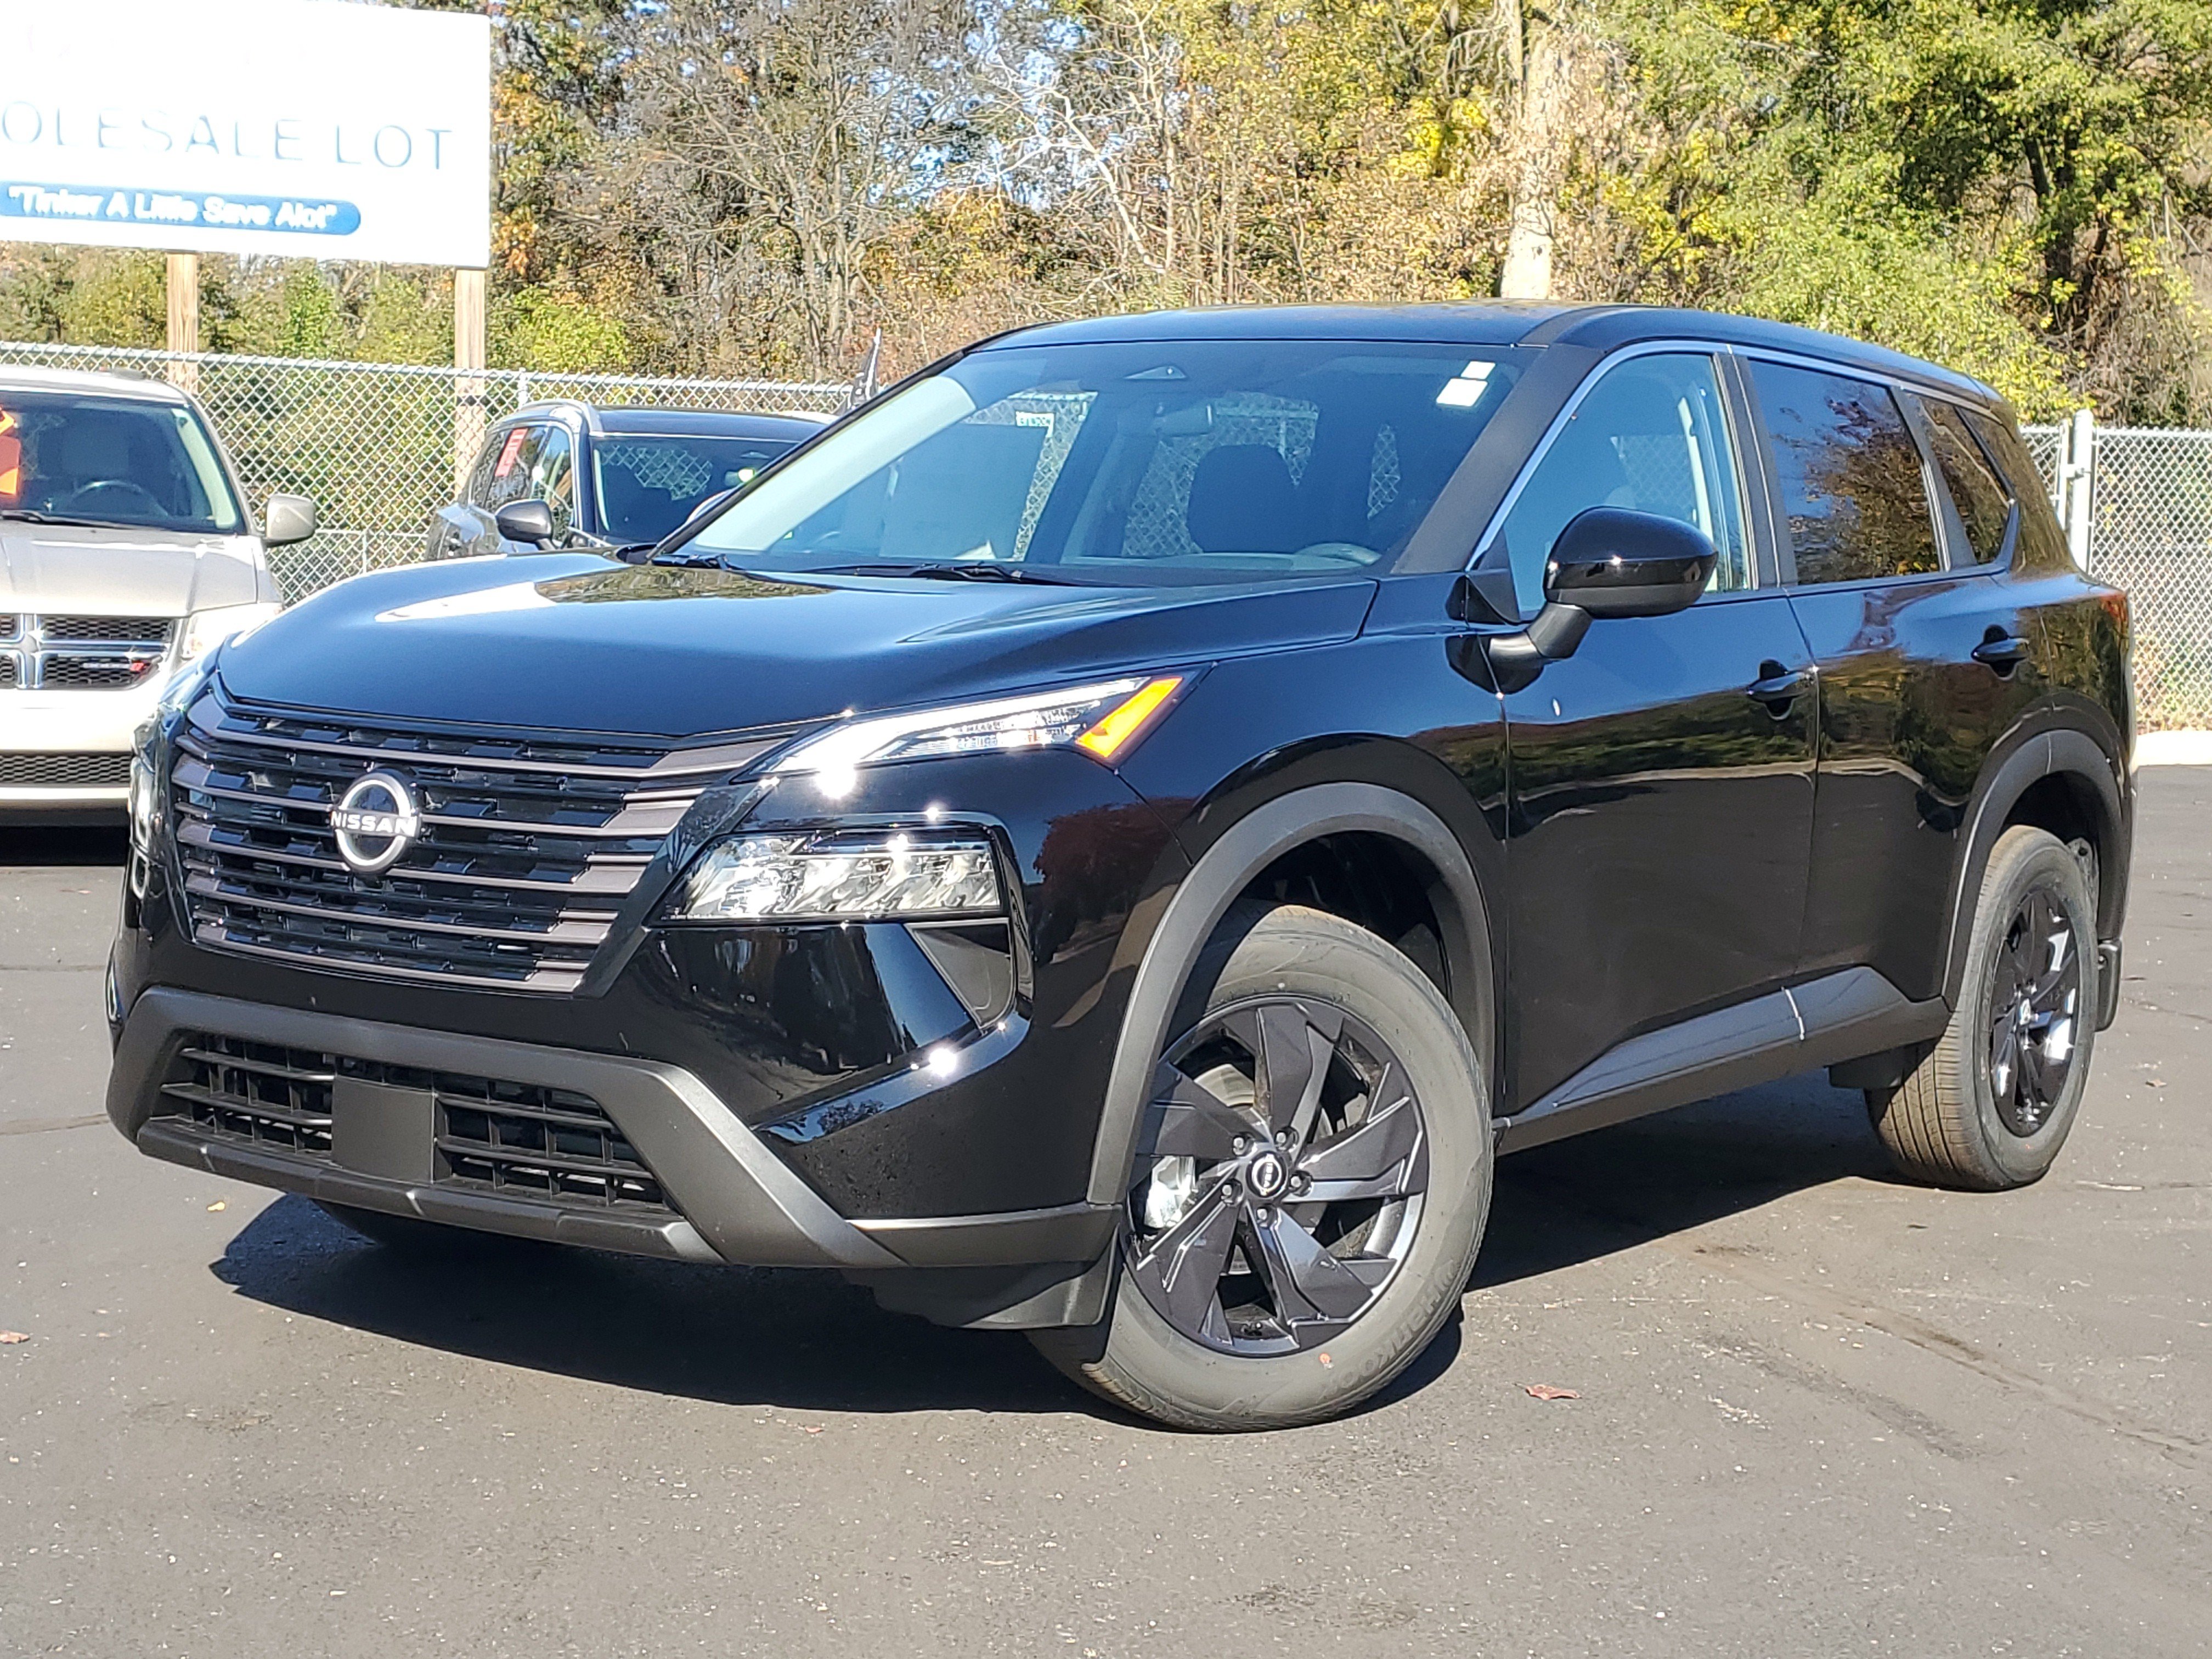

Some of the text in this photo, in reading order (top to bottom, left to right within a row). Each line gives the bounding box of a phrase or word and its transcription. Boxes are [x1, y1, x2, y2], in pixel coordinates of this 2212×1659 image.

[335, 124, 453, 170] LOT
[106, 191, 129, 218] A
[331, 810, 417, 838] NISSAN
